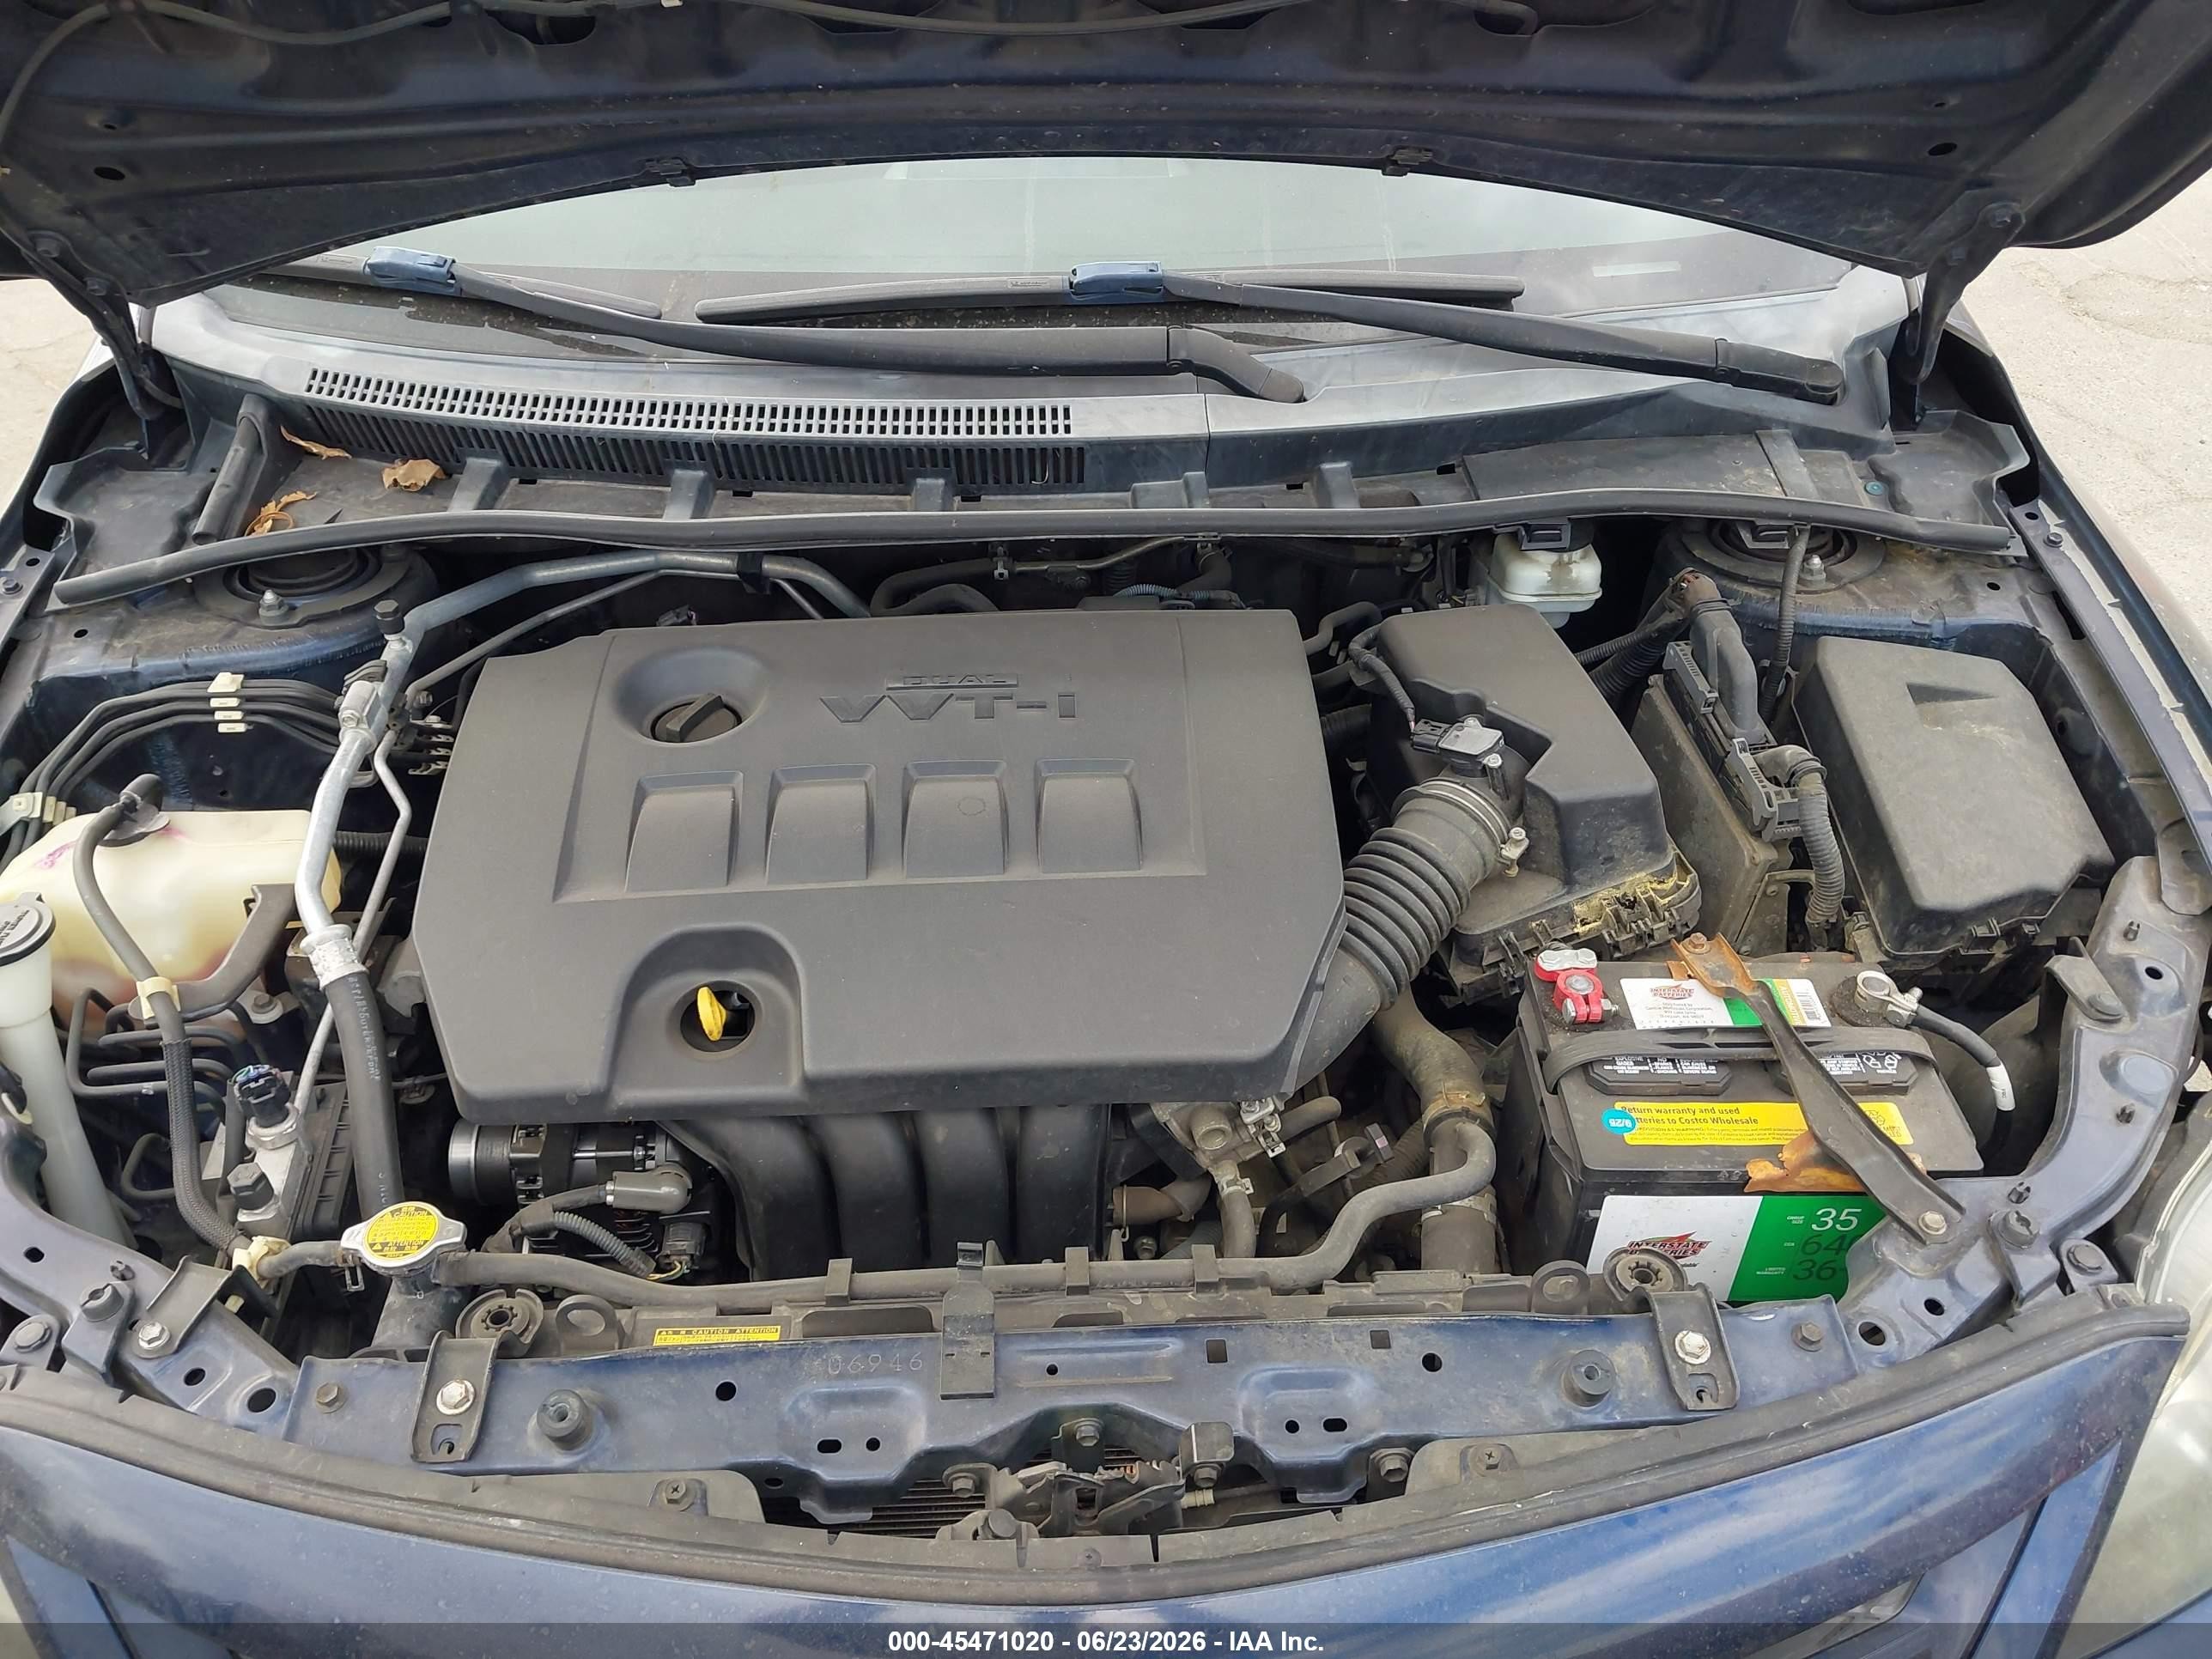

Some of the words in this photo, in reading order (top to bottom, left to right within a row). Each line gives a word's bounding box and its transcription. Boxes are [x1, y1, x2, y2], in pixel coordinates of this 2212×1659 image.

[1621, 1106, 1653, 1115] Return
[1655, 1107, 1697, 1115] warranty
[1634, 1116, 1666, 1125] tteries
[1710, 1116, 1759, 1125] Wholesale
[1811, 1207, 1862, 1231] 35
[1629, 1241, 1708, 1249] INTERSTATE
